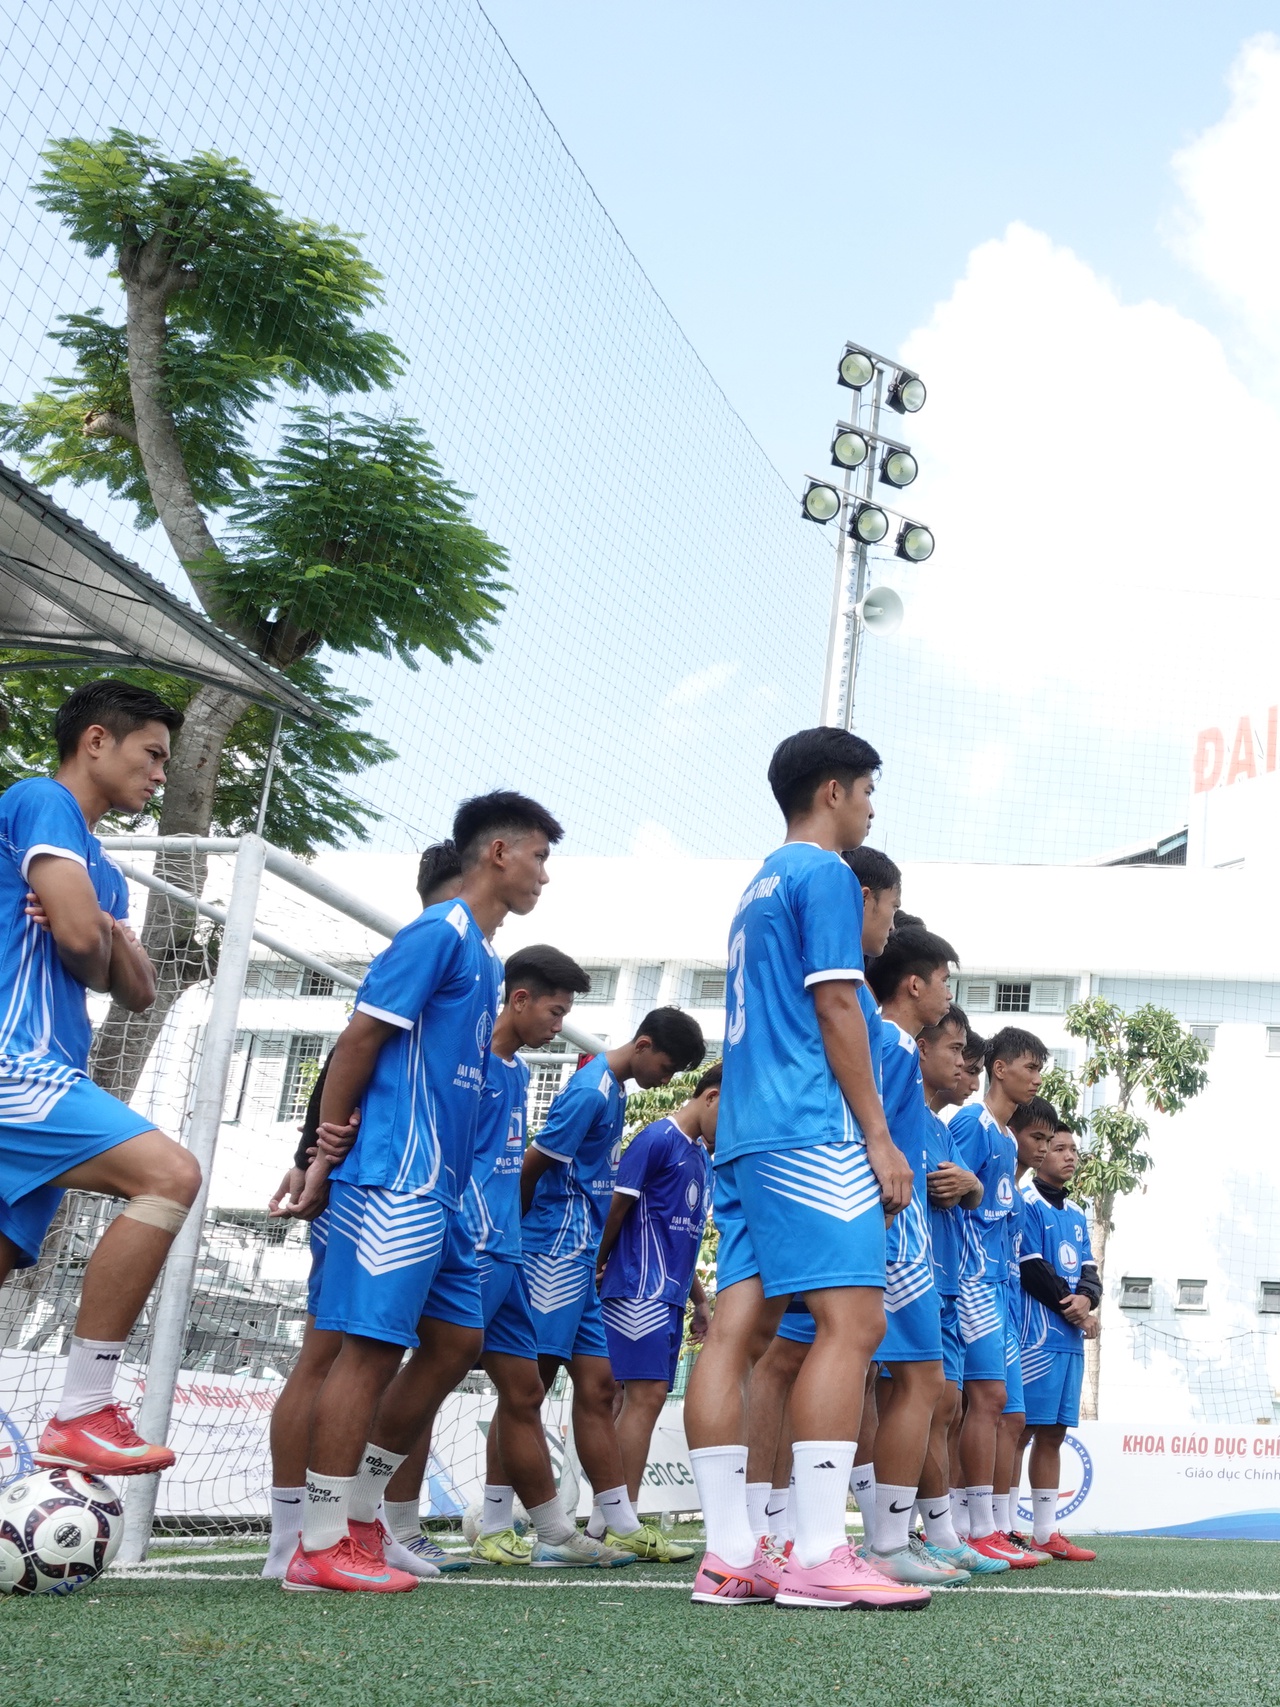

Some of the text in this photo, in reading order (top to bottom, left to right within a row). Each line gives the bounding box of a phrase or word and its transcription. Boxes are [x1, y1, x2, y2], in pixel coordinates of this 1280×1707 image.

[1123, 1435, 1165, 1453] KHOA
[1171, 1433, 1209, 1455] GIÁO
[1214, 1437, 1247, 1460] DỤC
[1185, 1467, 1213, 1479] Giáo
[1217, 1467, 1240, 1482] dục
[1244, 1468, 1280, 1480] Chính
